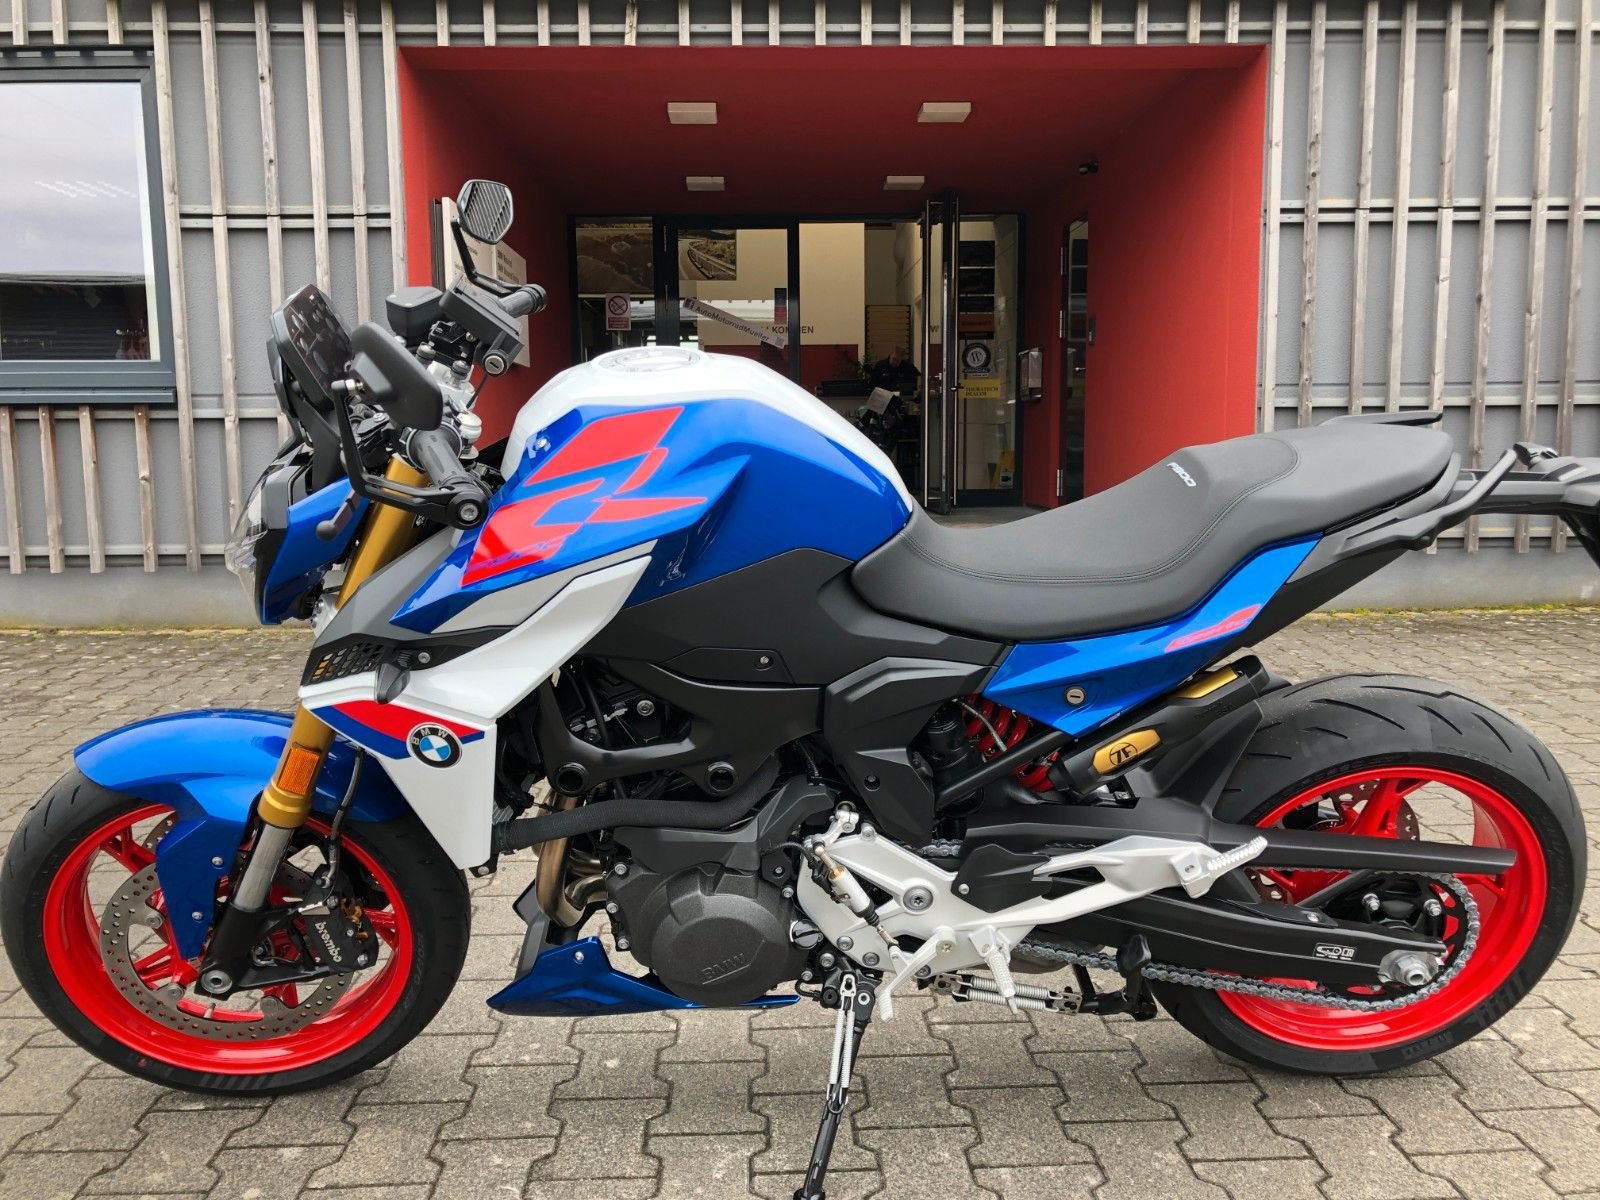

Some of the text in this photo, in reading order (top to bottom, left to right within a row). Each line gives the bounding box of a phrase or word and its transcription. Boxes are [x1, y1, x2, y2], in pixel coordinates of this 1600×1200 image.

[412, 727, 449, 746] BMW
[1110, 743, 1137, 765] ZF
[314, 921, 343, 963] brembo
